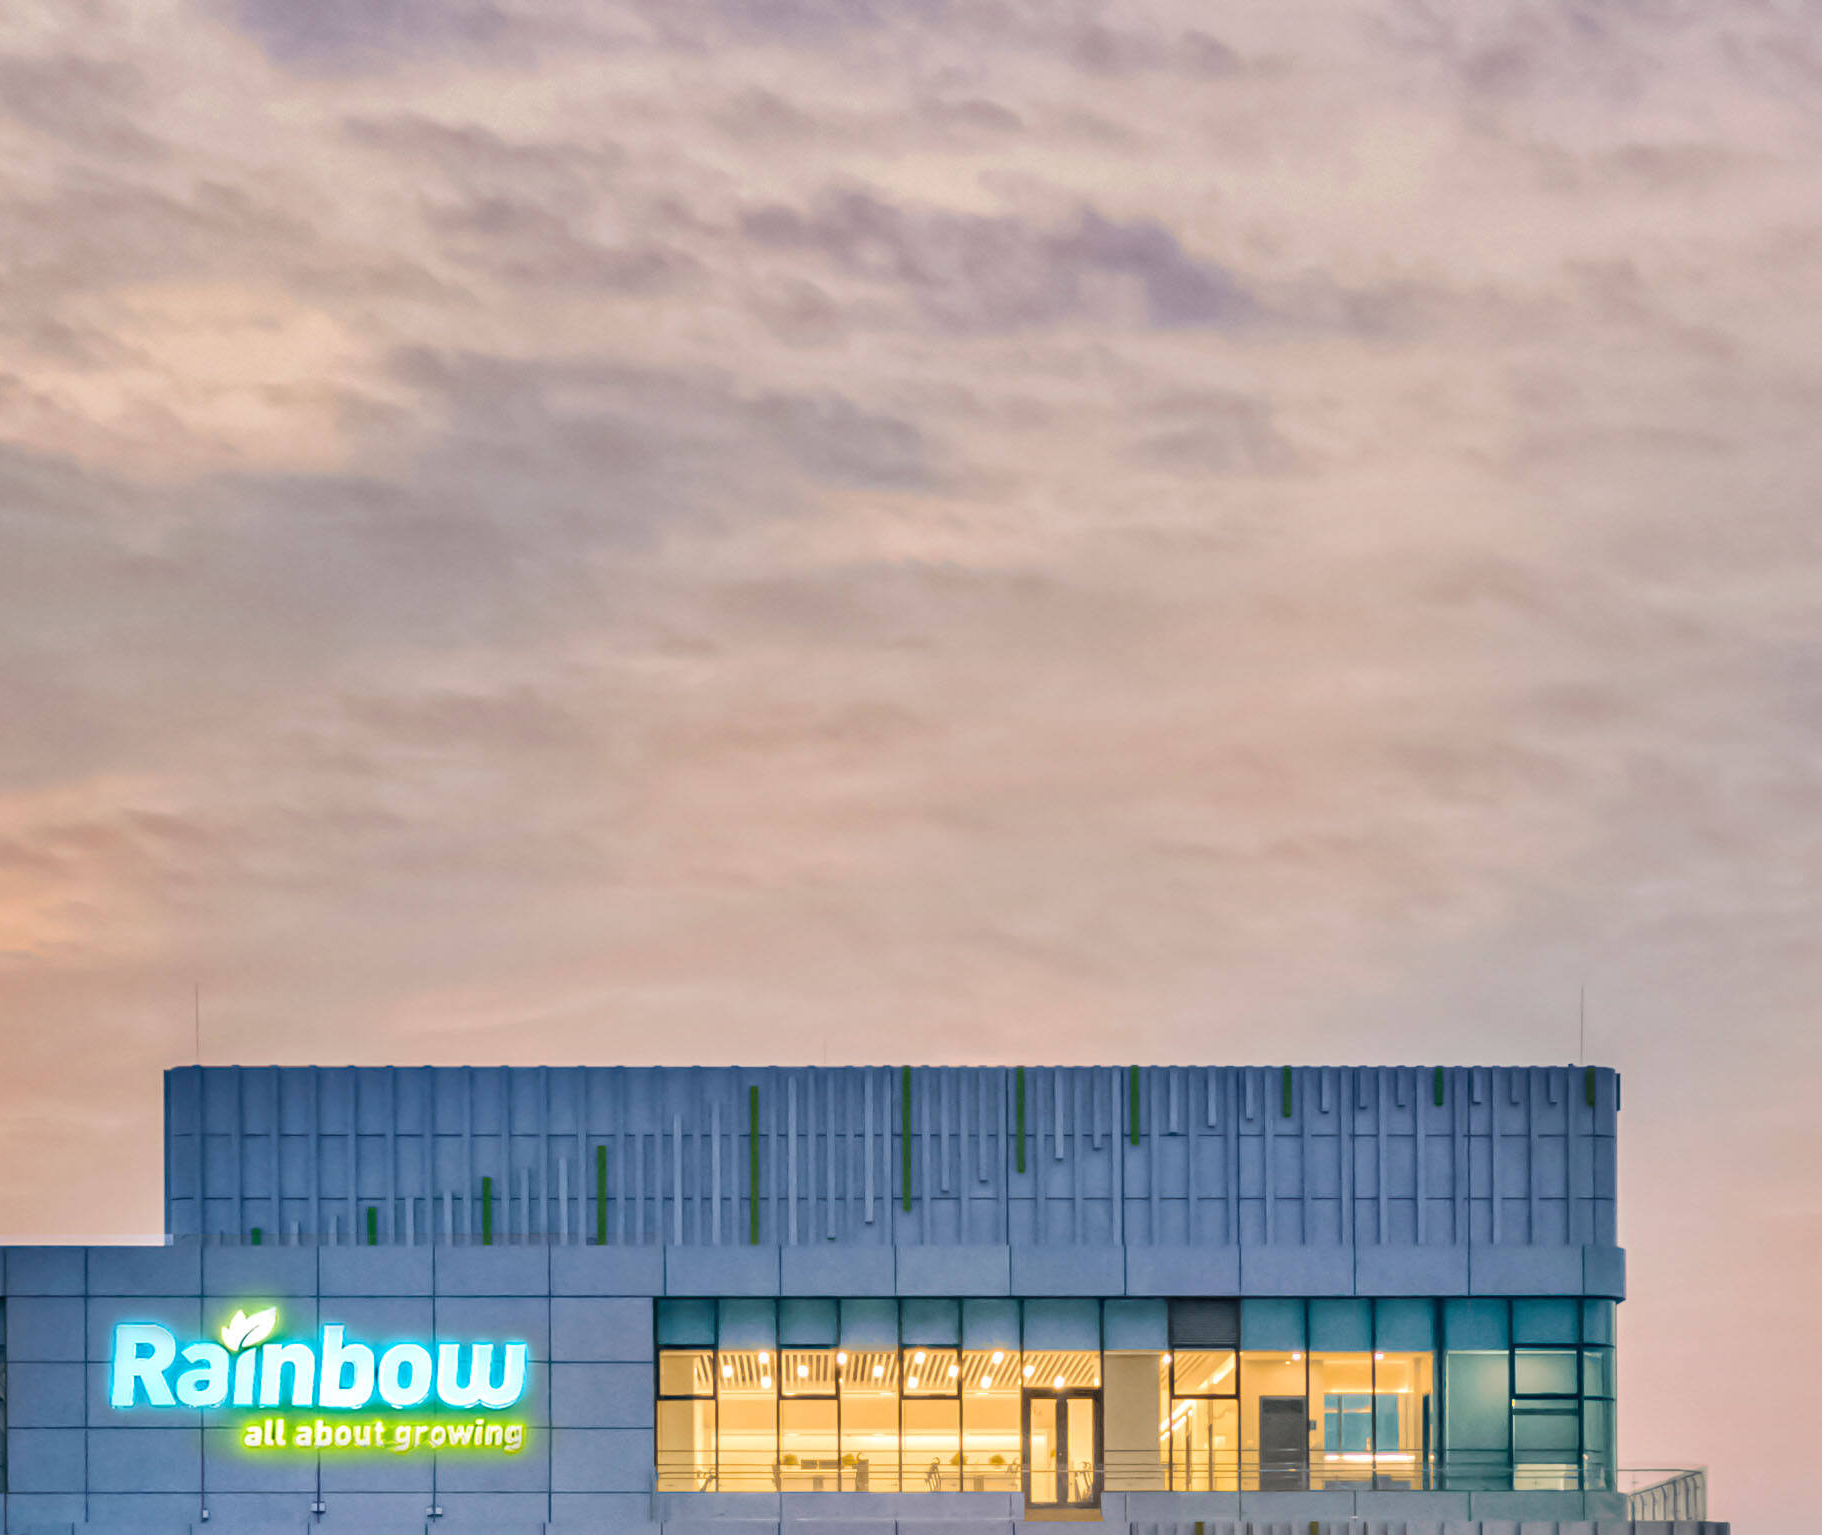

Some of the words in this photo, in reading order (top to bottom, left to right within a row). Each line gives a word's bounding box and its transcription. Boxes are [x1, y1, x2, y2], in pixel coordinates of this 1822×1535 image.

[111, 1322, 528, 1409] Rainbow
[243, 1419, 286, 1447] all
[294, 1419, 385, 1448] about
[394, 1419, 524, 1454] growing
